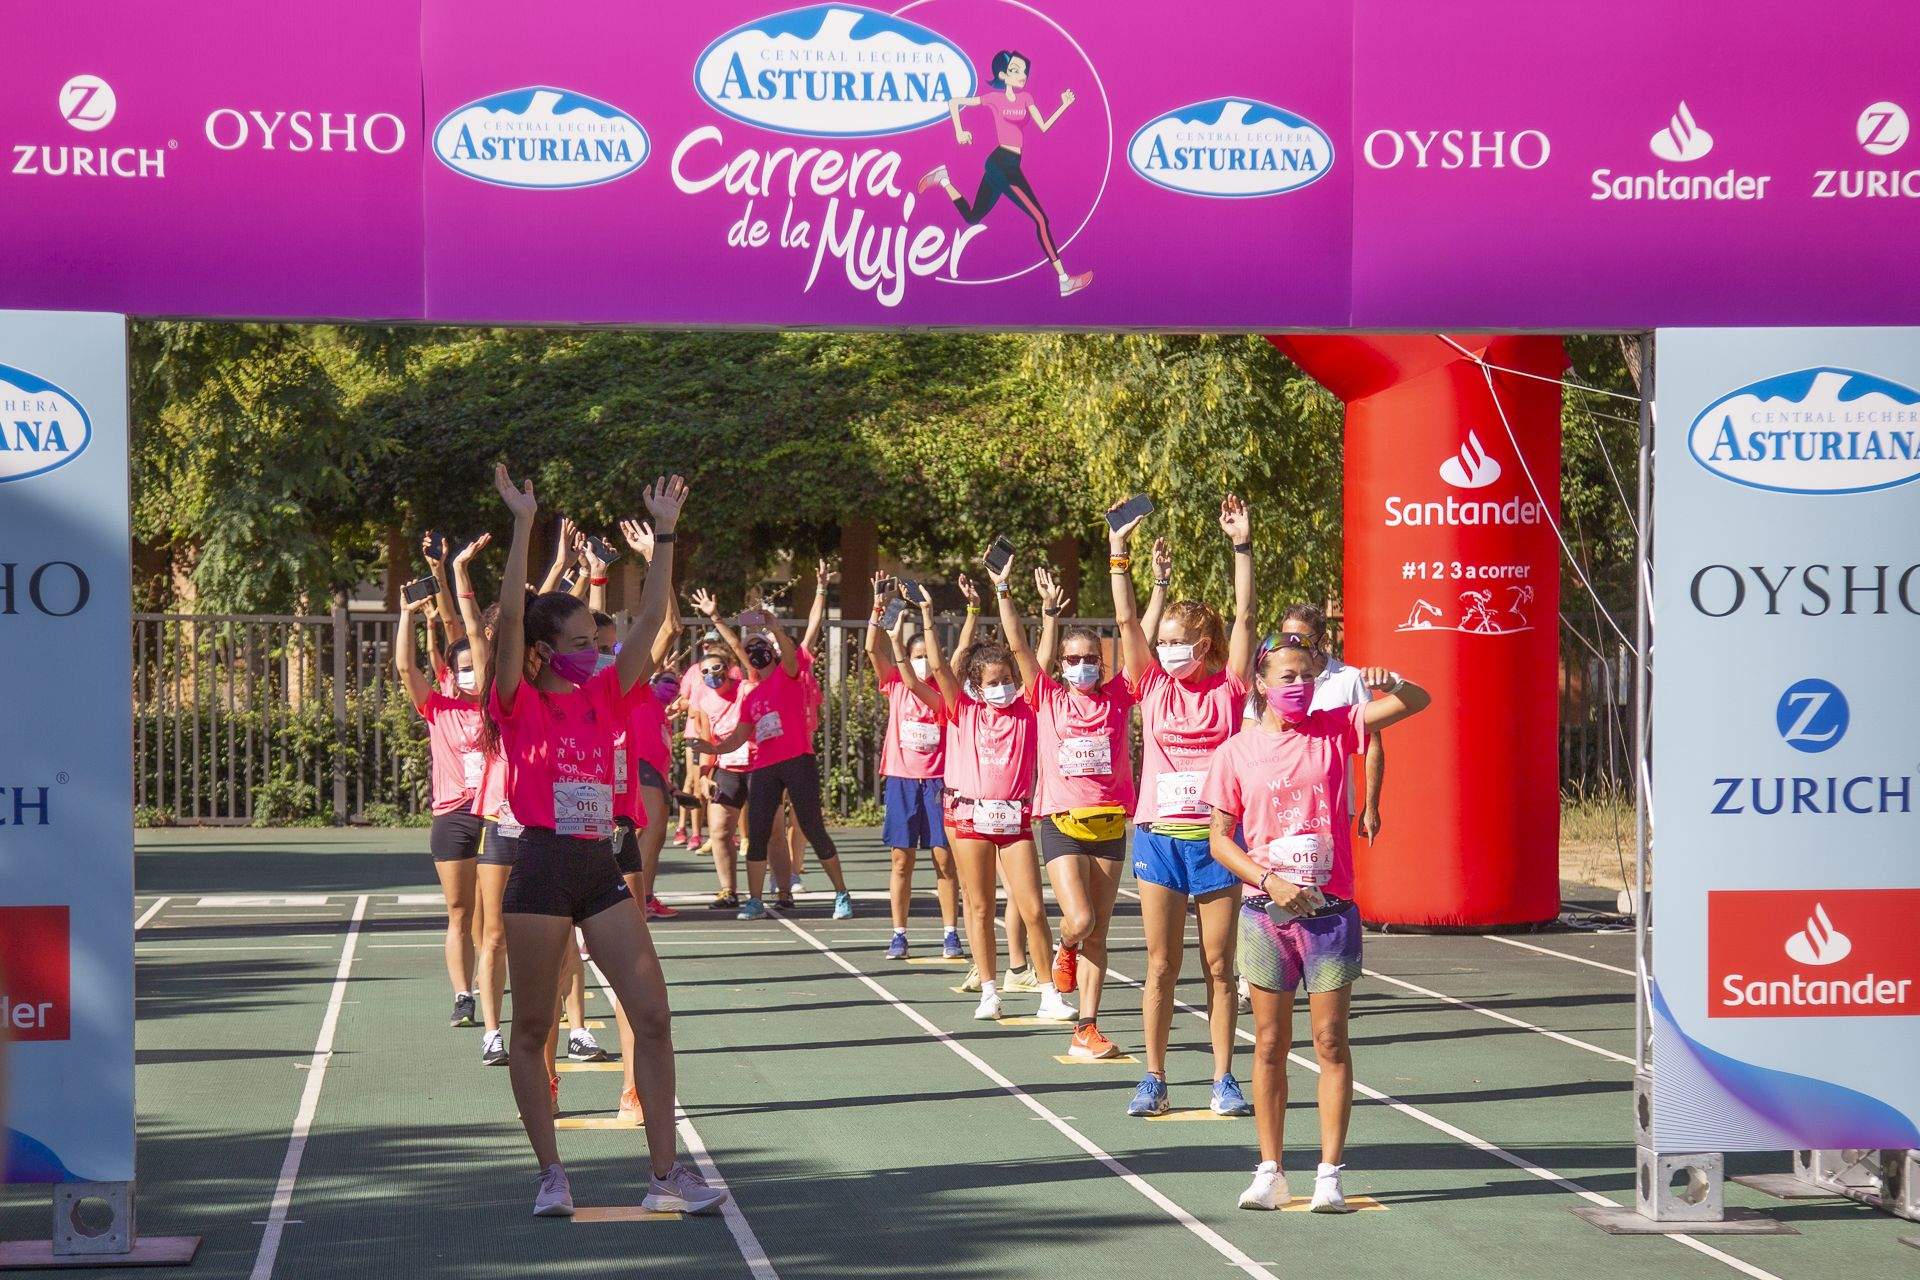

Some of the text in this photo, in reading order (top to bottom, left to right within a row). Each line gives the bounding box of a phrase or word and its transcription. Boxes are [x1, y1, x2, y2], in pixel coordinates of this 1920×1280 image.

[760, 49, 945, 64] CENTRAL LECHERA
[717, 51, 952, 103] ASTURIANA
[205, 108, 405, 154] OYSHO
[451, 122, 633, 162] ASTURIANA
[483, 121, 626, 133] CENTRAL LECHERA
[1176, 131, 1312, 143] CENTRAL LECHERA
[12, 145, 166, 178] ZURICH
[671, 126, 902, 198] Carrera
[1145, 133, 1318, 171] ASTURIANA
[1363, 128, 1551, 170] OYSHO
[1590, 168, 1771, 201] Santander
[727, 192, 988, 308] de la Mujer
[1751, 411, 1836, 423] CENTRAL
[1708, 414, 1920, 461] ASTURIAN
[1384, 495, 1544, 527] Santander
[1076, 750, 1095, 758] 016
[1174, 786, 1197, 795] 016
[1267, 777, 1293, 791] WE
[1710, 776, 1912, 815] ZURICH
[577, 801, 598, 812] 016
[988, 812, 1006, 820] 016
[1276, 799, 1329, 823] FOR A
[1293, 852, 1318, 863] 016
[1722, 972, 1912, 1007] Santander
